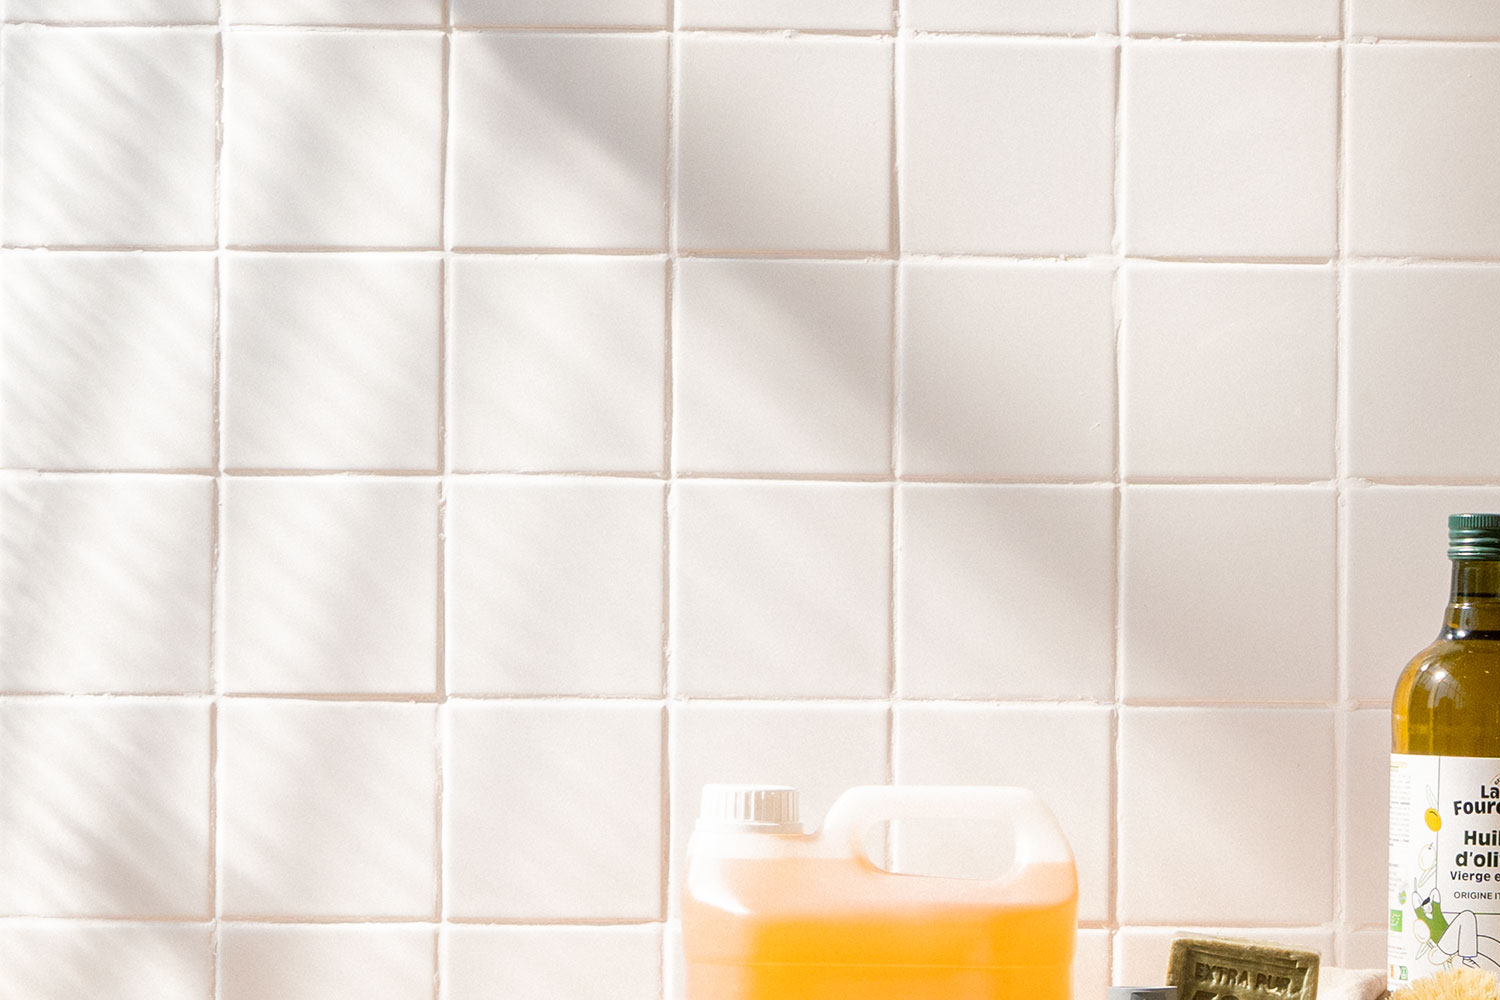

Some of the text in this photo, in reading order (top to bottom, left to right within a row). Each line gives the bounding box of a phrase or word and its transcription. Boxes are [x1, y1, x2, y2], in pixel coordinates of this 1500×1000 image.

[1481, 785, 1500, 799] La
[1450, 870, 1491, 884] Vierge
[1453, 891, 1492, 900] ORIGINE
[1195, 962, 1250, 988] EXTRA
